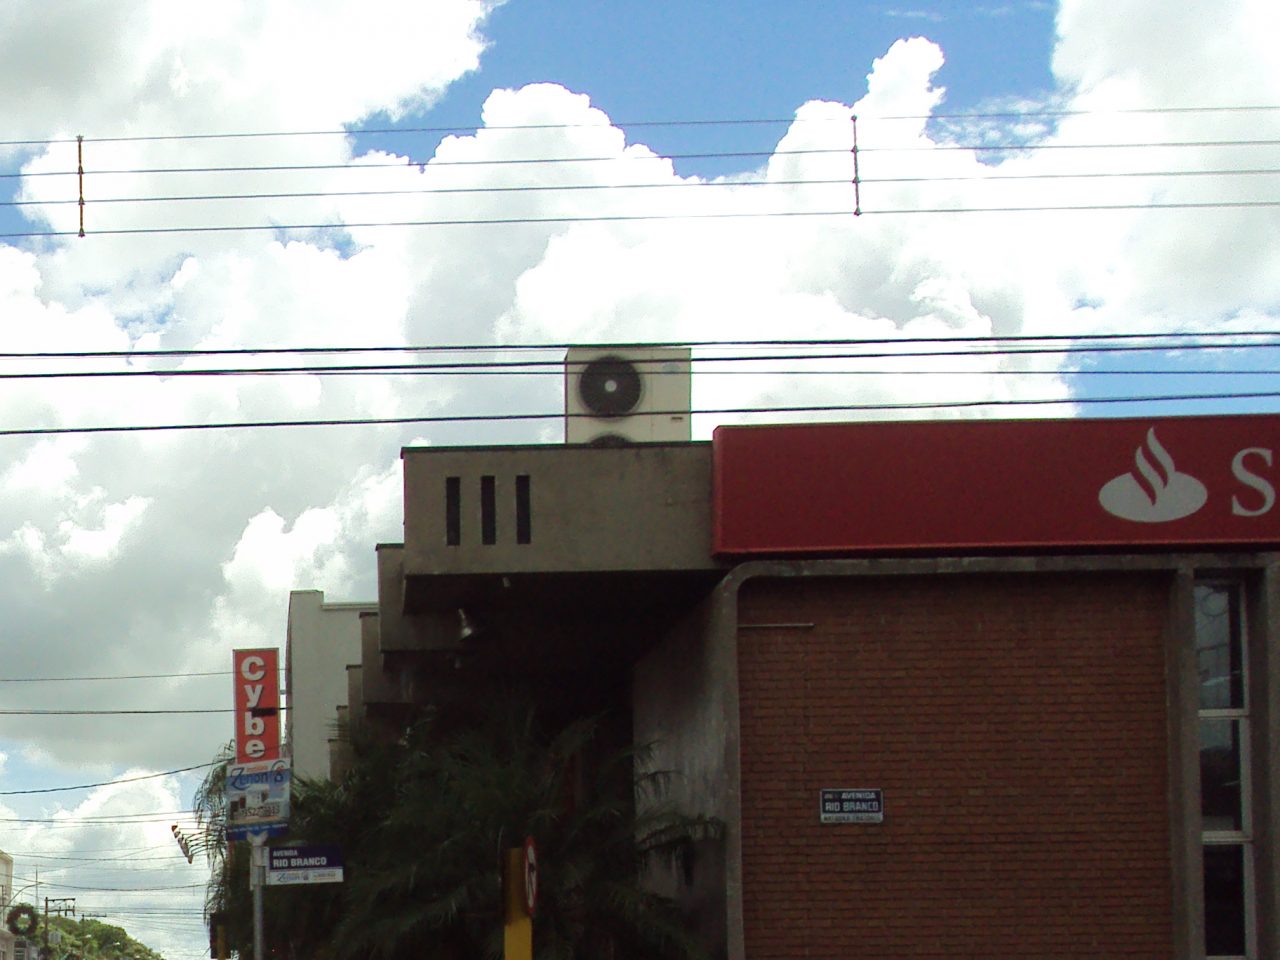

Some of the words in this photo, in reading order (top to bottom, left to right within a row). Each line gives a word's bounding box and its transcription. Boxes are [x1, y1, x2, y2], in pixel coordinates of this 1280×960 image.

[1231, 447, 1276, 517] S
[825, 801, 840, 811] RIO
[843, 801, 879, 811] BRANCO
[274, 859, 288, 867] RIO
[291, 857, 327, 866] BRANCO
